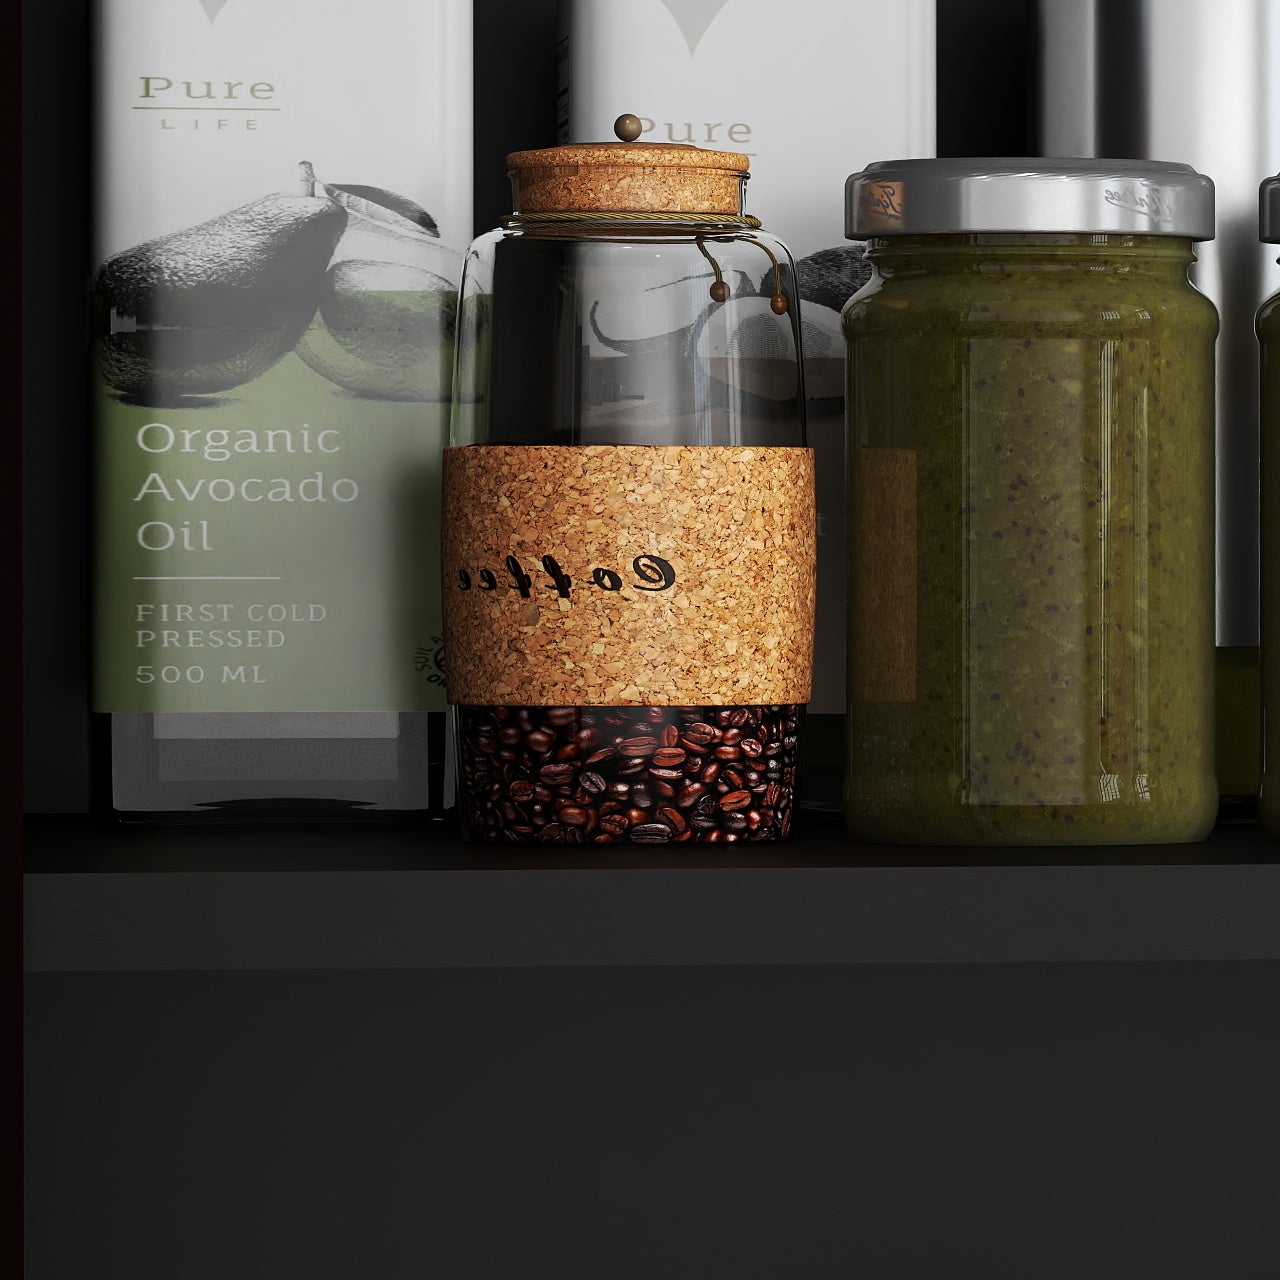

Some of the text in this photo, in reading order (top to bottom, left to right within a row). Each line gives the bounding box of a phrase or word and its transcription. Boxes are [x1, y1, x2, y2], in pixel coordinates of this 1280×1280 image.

[138, 75, 276, 101] Pure
[160, 118, 258, 131] LIFE
[136, 422, 341, 461] Organic
[133, 471, 360, 503] Avocado
[136, 519, 213, 552] Oil
[136, 603, 327, 623] FIRST COLD
[136, 629, 286, 649] PRESSED
[136, 665, 267, 684] 500 ML
